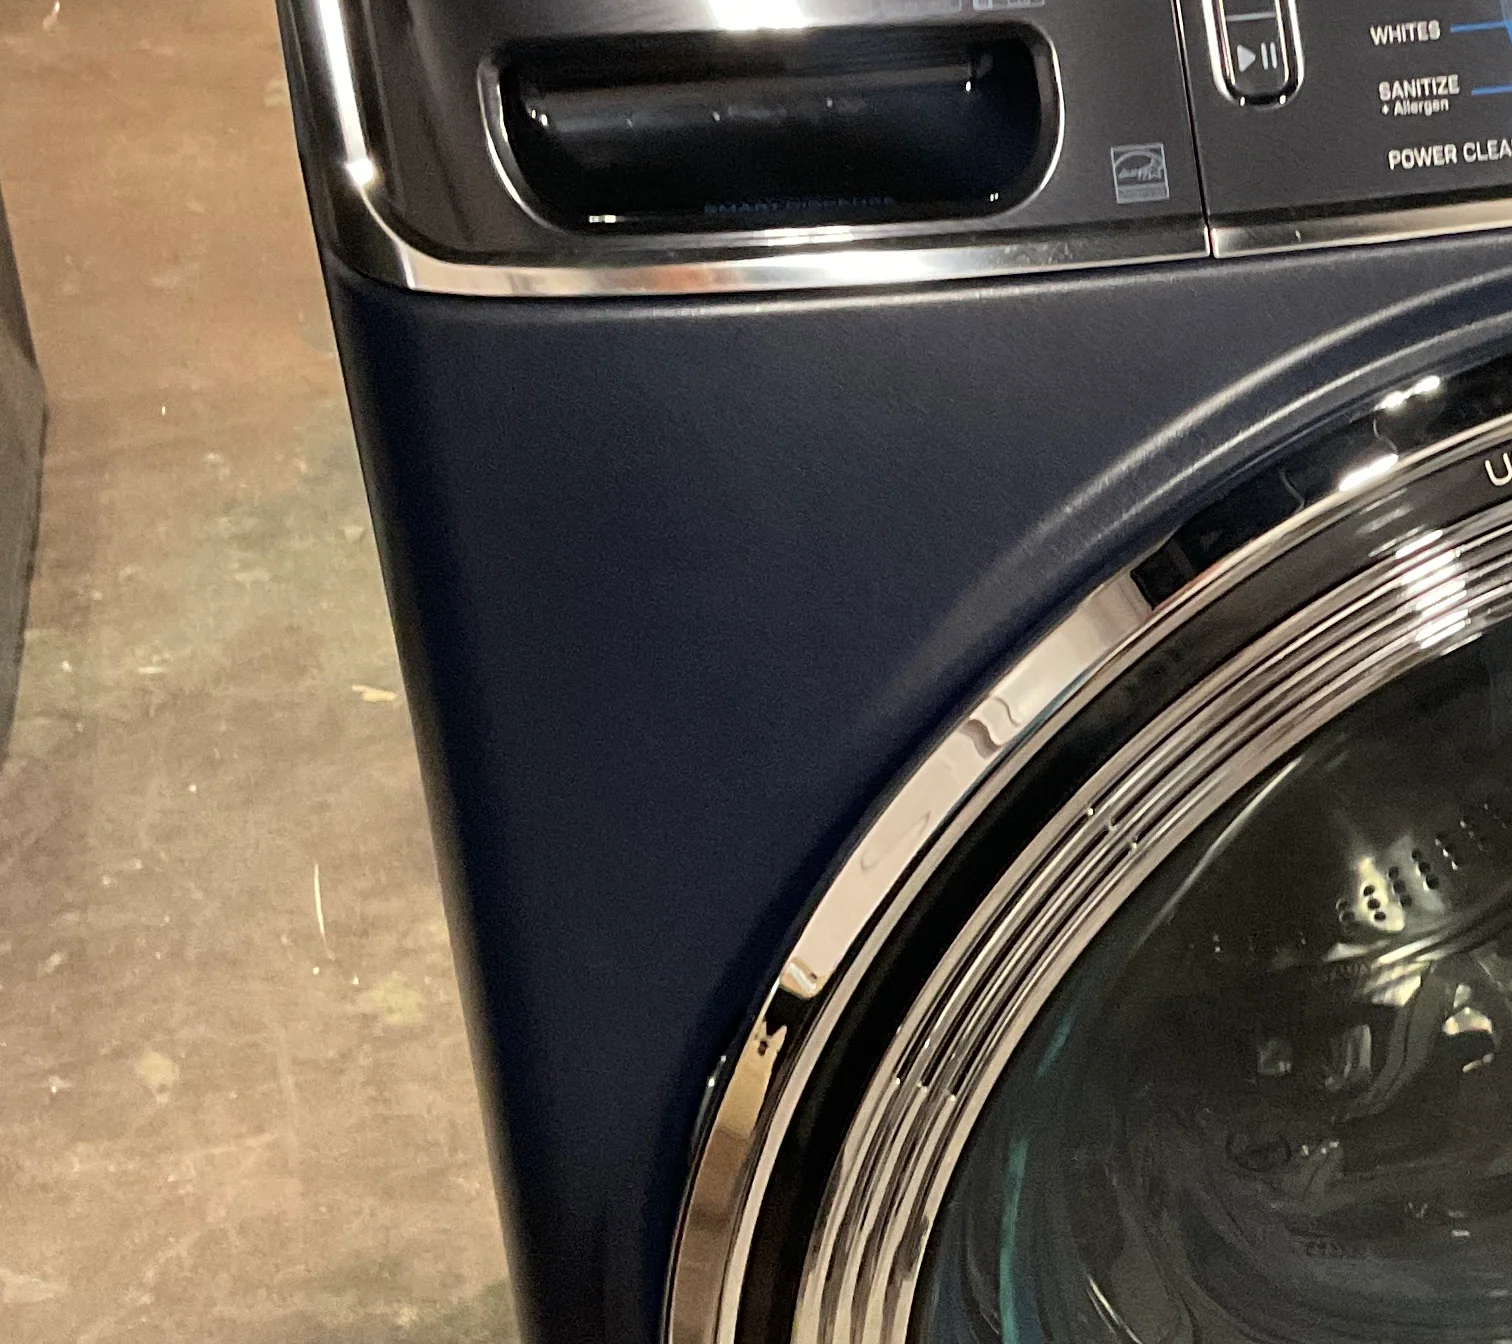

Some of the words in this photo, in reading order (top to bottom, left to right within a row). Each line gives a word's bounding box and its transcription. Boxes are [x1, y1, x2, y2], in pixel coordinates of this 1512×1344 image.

[1370, 20, 1441, 46] WHITES
[1378, 73, 1460, 101] SANITIZE
[1393, 97, 1450, 117] Allergen
[1388, 144, 1458, 170] POWER
